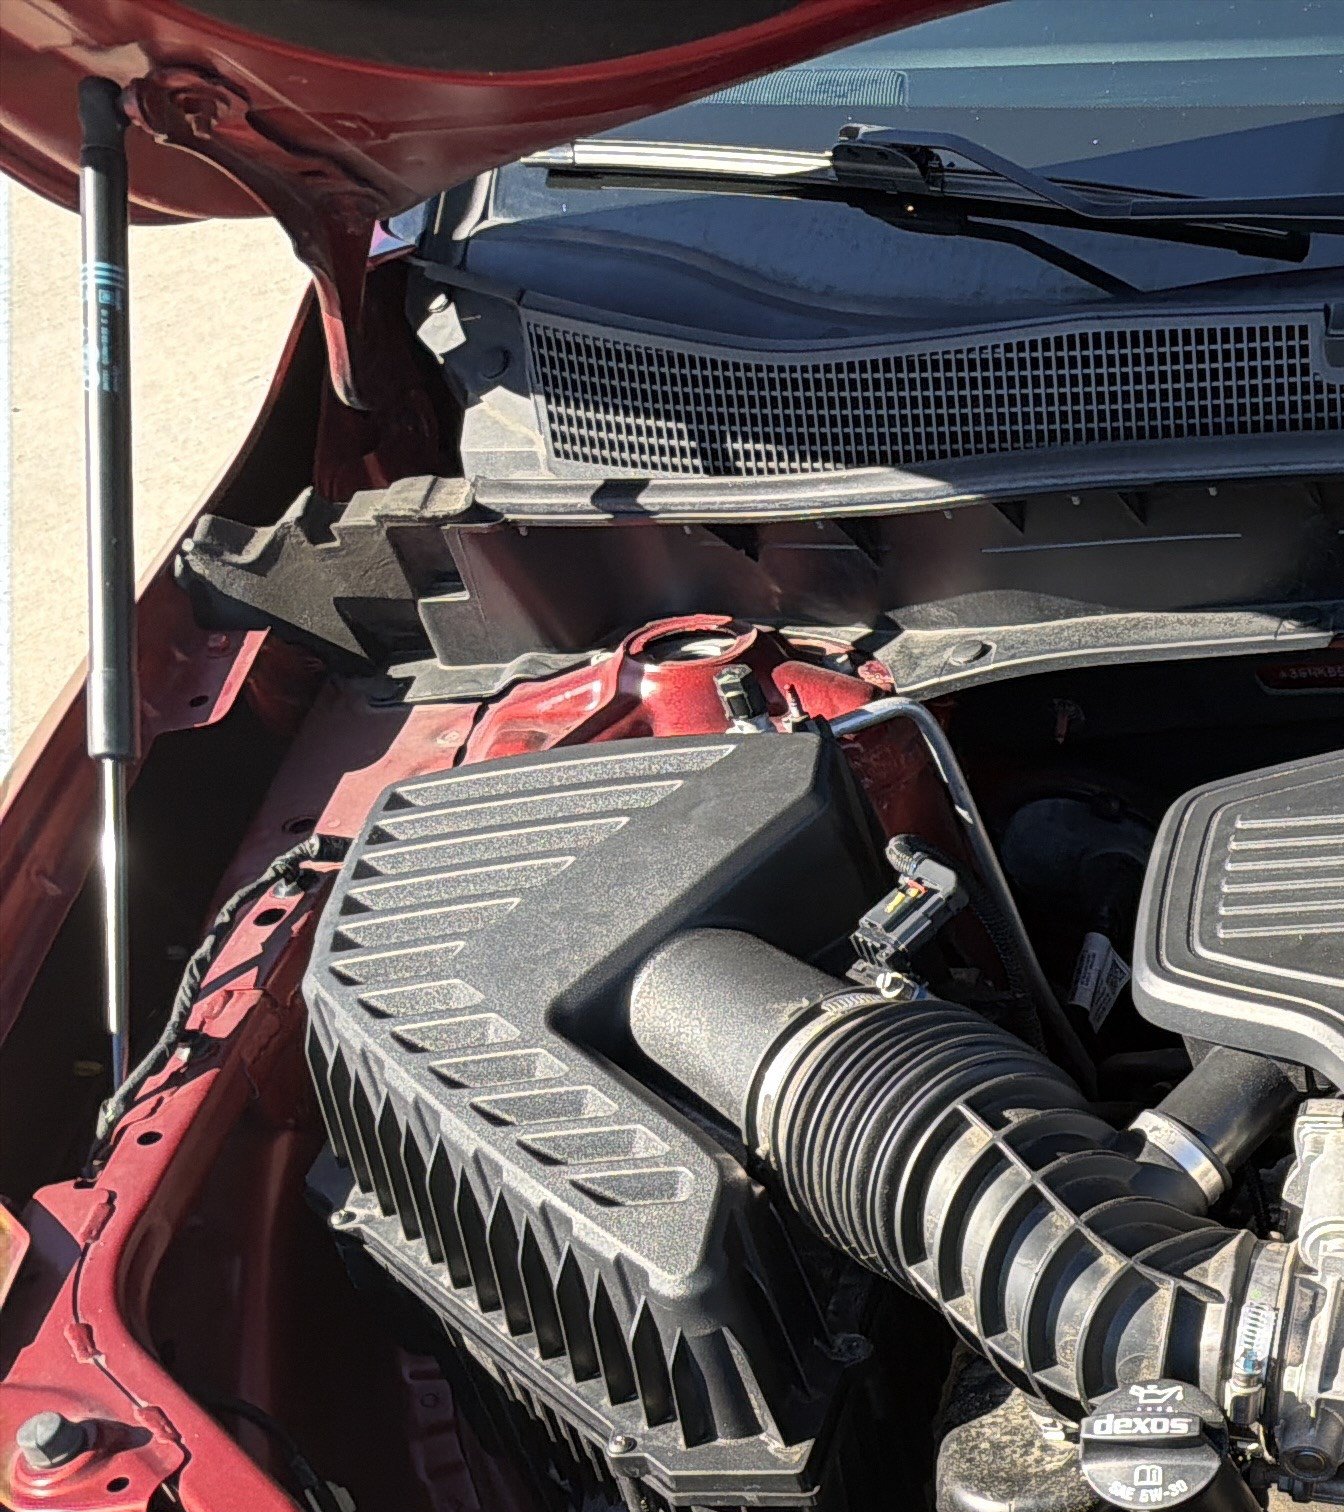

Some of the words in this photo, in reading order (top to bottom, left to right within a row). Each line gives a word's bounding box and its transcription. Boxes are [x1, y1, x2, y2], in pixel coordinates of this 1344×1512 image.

[1093, 1414, 1193, 1435] dexos
[1108, 1481, 1136, 1501] SAE
[1139, 1480, 1189, 1503] 5W-30
